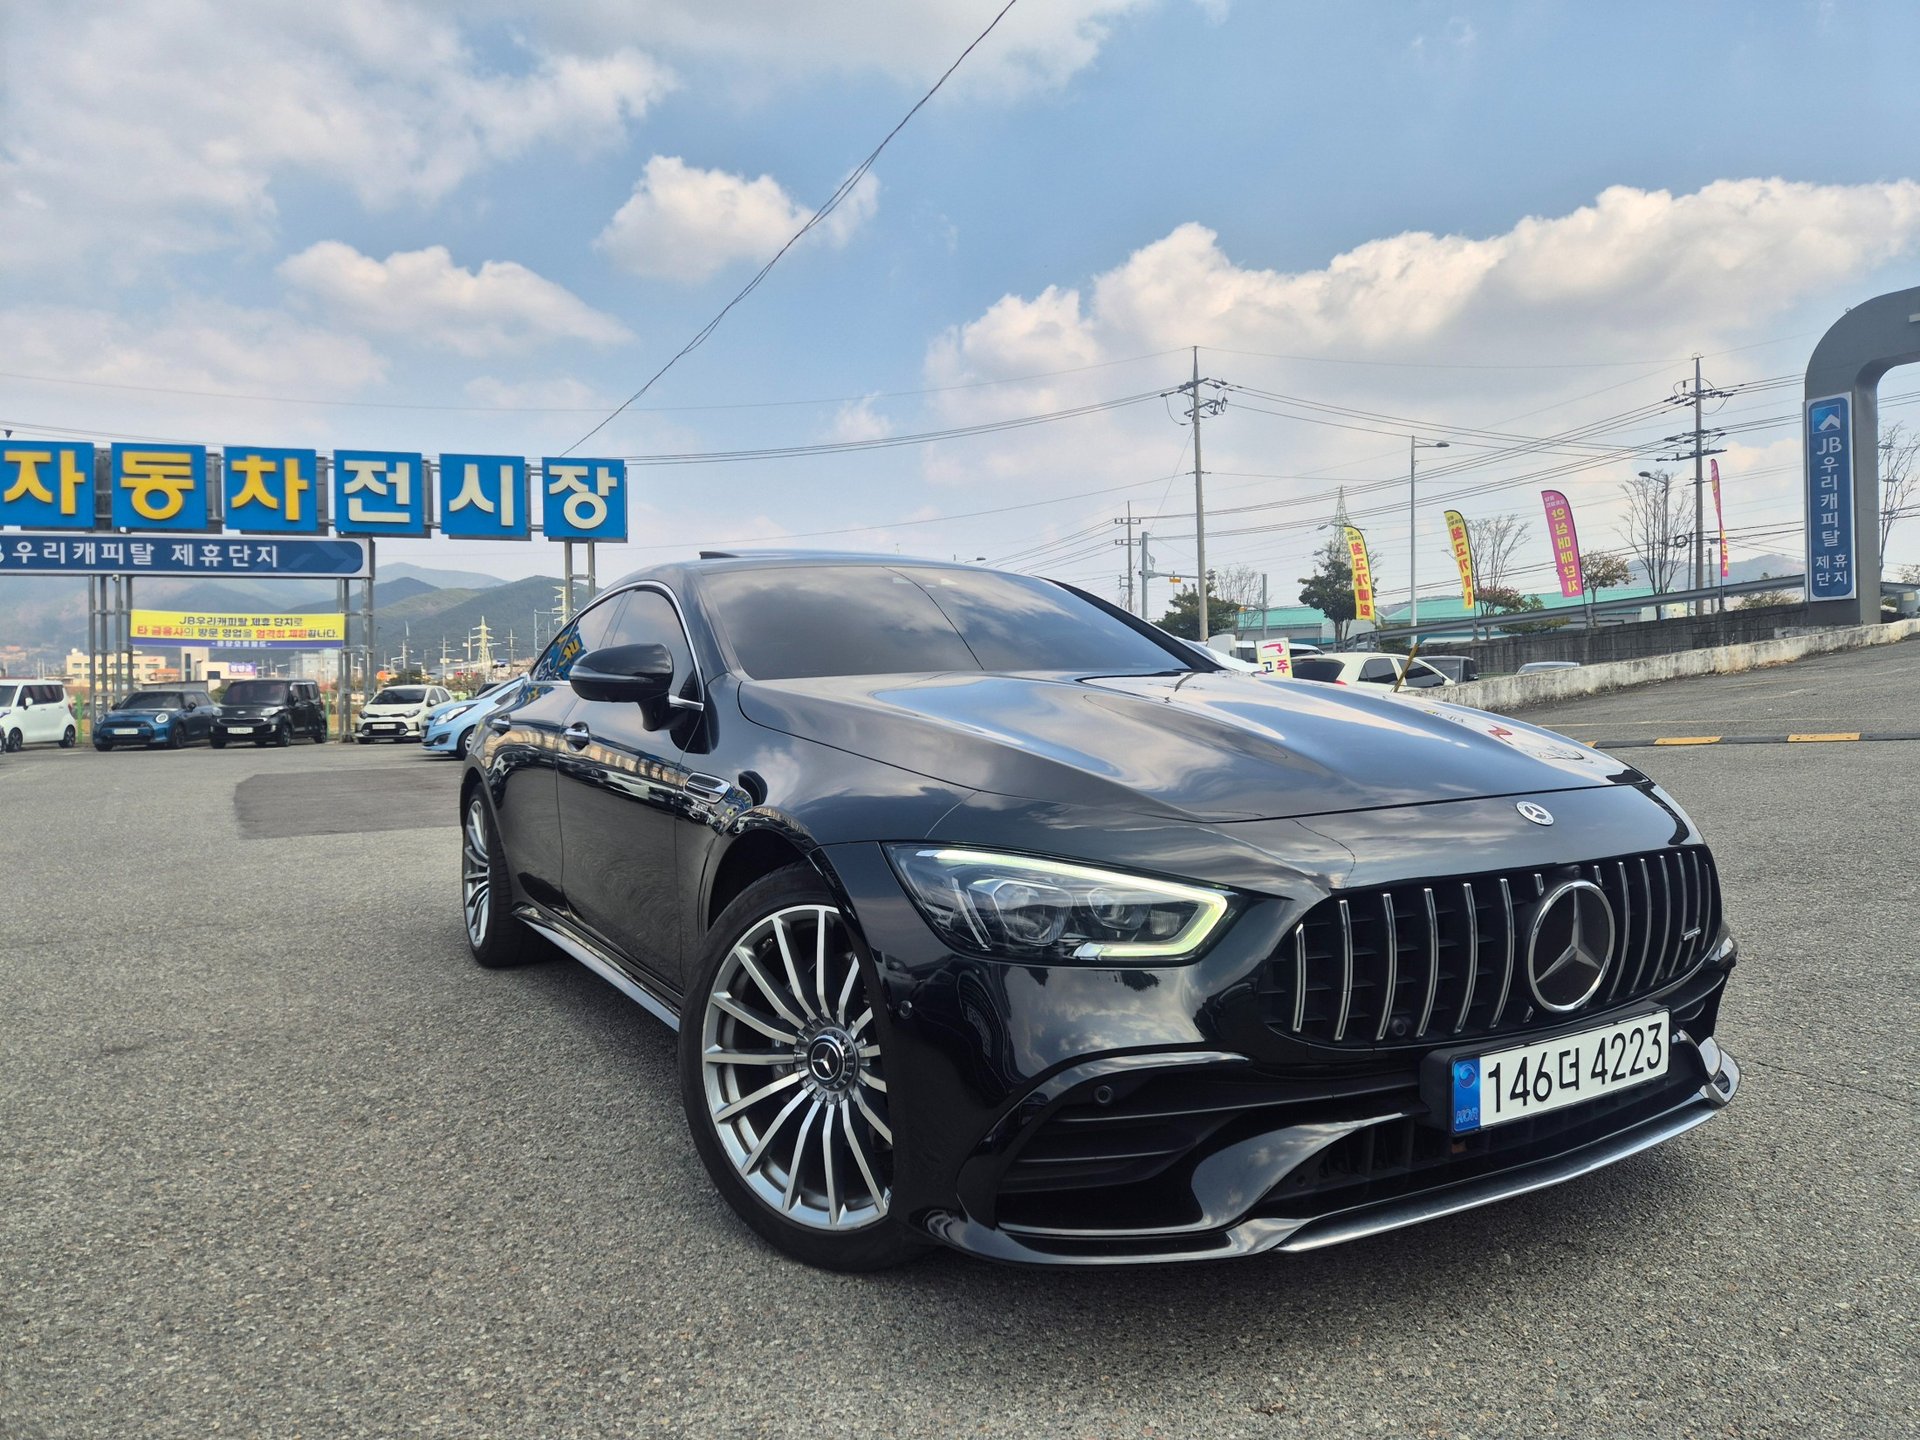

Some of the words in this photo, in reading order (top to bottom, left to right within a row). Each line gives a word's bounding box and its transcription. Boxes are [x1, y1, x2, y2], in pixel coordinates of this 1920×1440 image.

[1815, 436, 1843, 547] JB우리캐피탈
[171, 543, 279, 568] 제휴단지
[1815, 553, 1848, 569] 제휴
[1815, 570, 1848, 586] 단지
[179, 616, 247, 627] JB우리캐피탈
[1488, 1047, 1580, 1114] 146더
[1590, 1021, 1663, 1086] 4223
[1455, 1106, 1479, 1125] KOR
